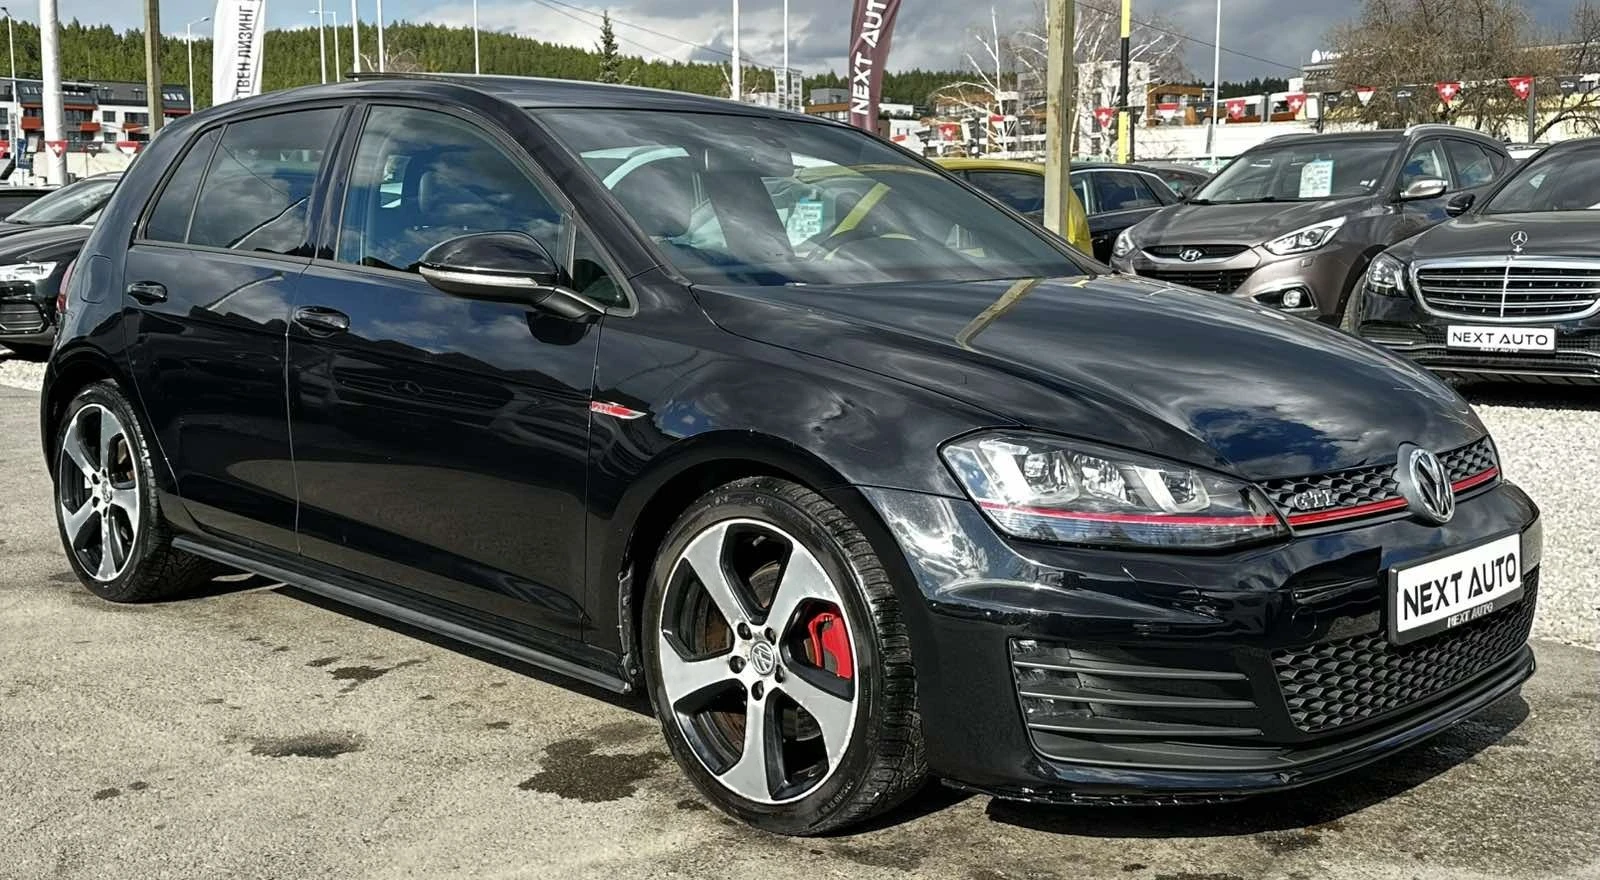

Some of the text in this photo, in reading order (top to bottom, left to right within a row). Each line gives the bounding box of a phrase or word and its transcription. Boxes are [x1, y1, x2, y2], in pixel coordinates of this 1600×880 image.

[235, 5, 253, 100] ТВЕН ЛИЗИНГ
[851, 51, 873, 115] NEXT
[1452, 331, 1548, 346] NEXT AUTO
[1294, 489, 1336, 511] GTI
[1403, 552, 1517, 621] NEXT AUTO
[1447, 601, 1494, 628] NEXT AUTO
